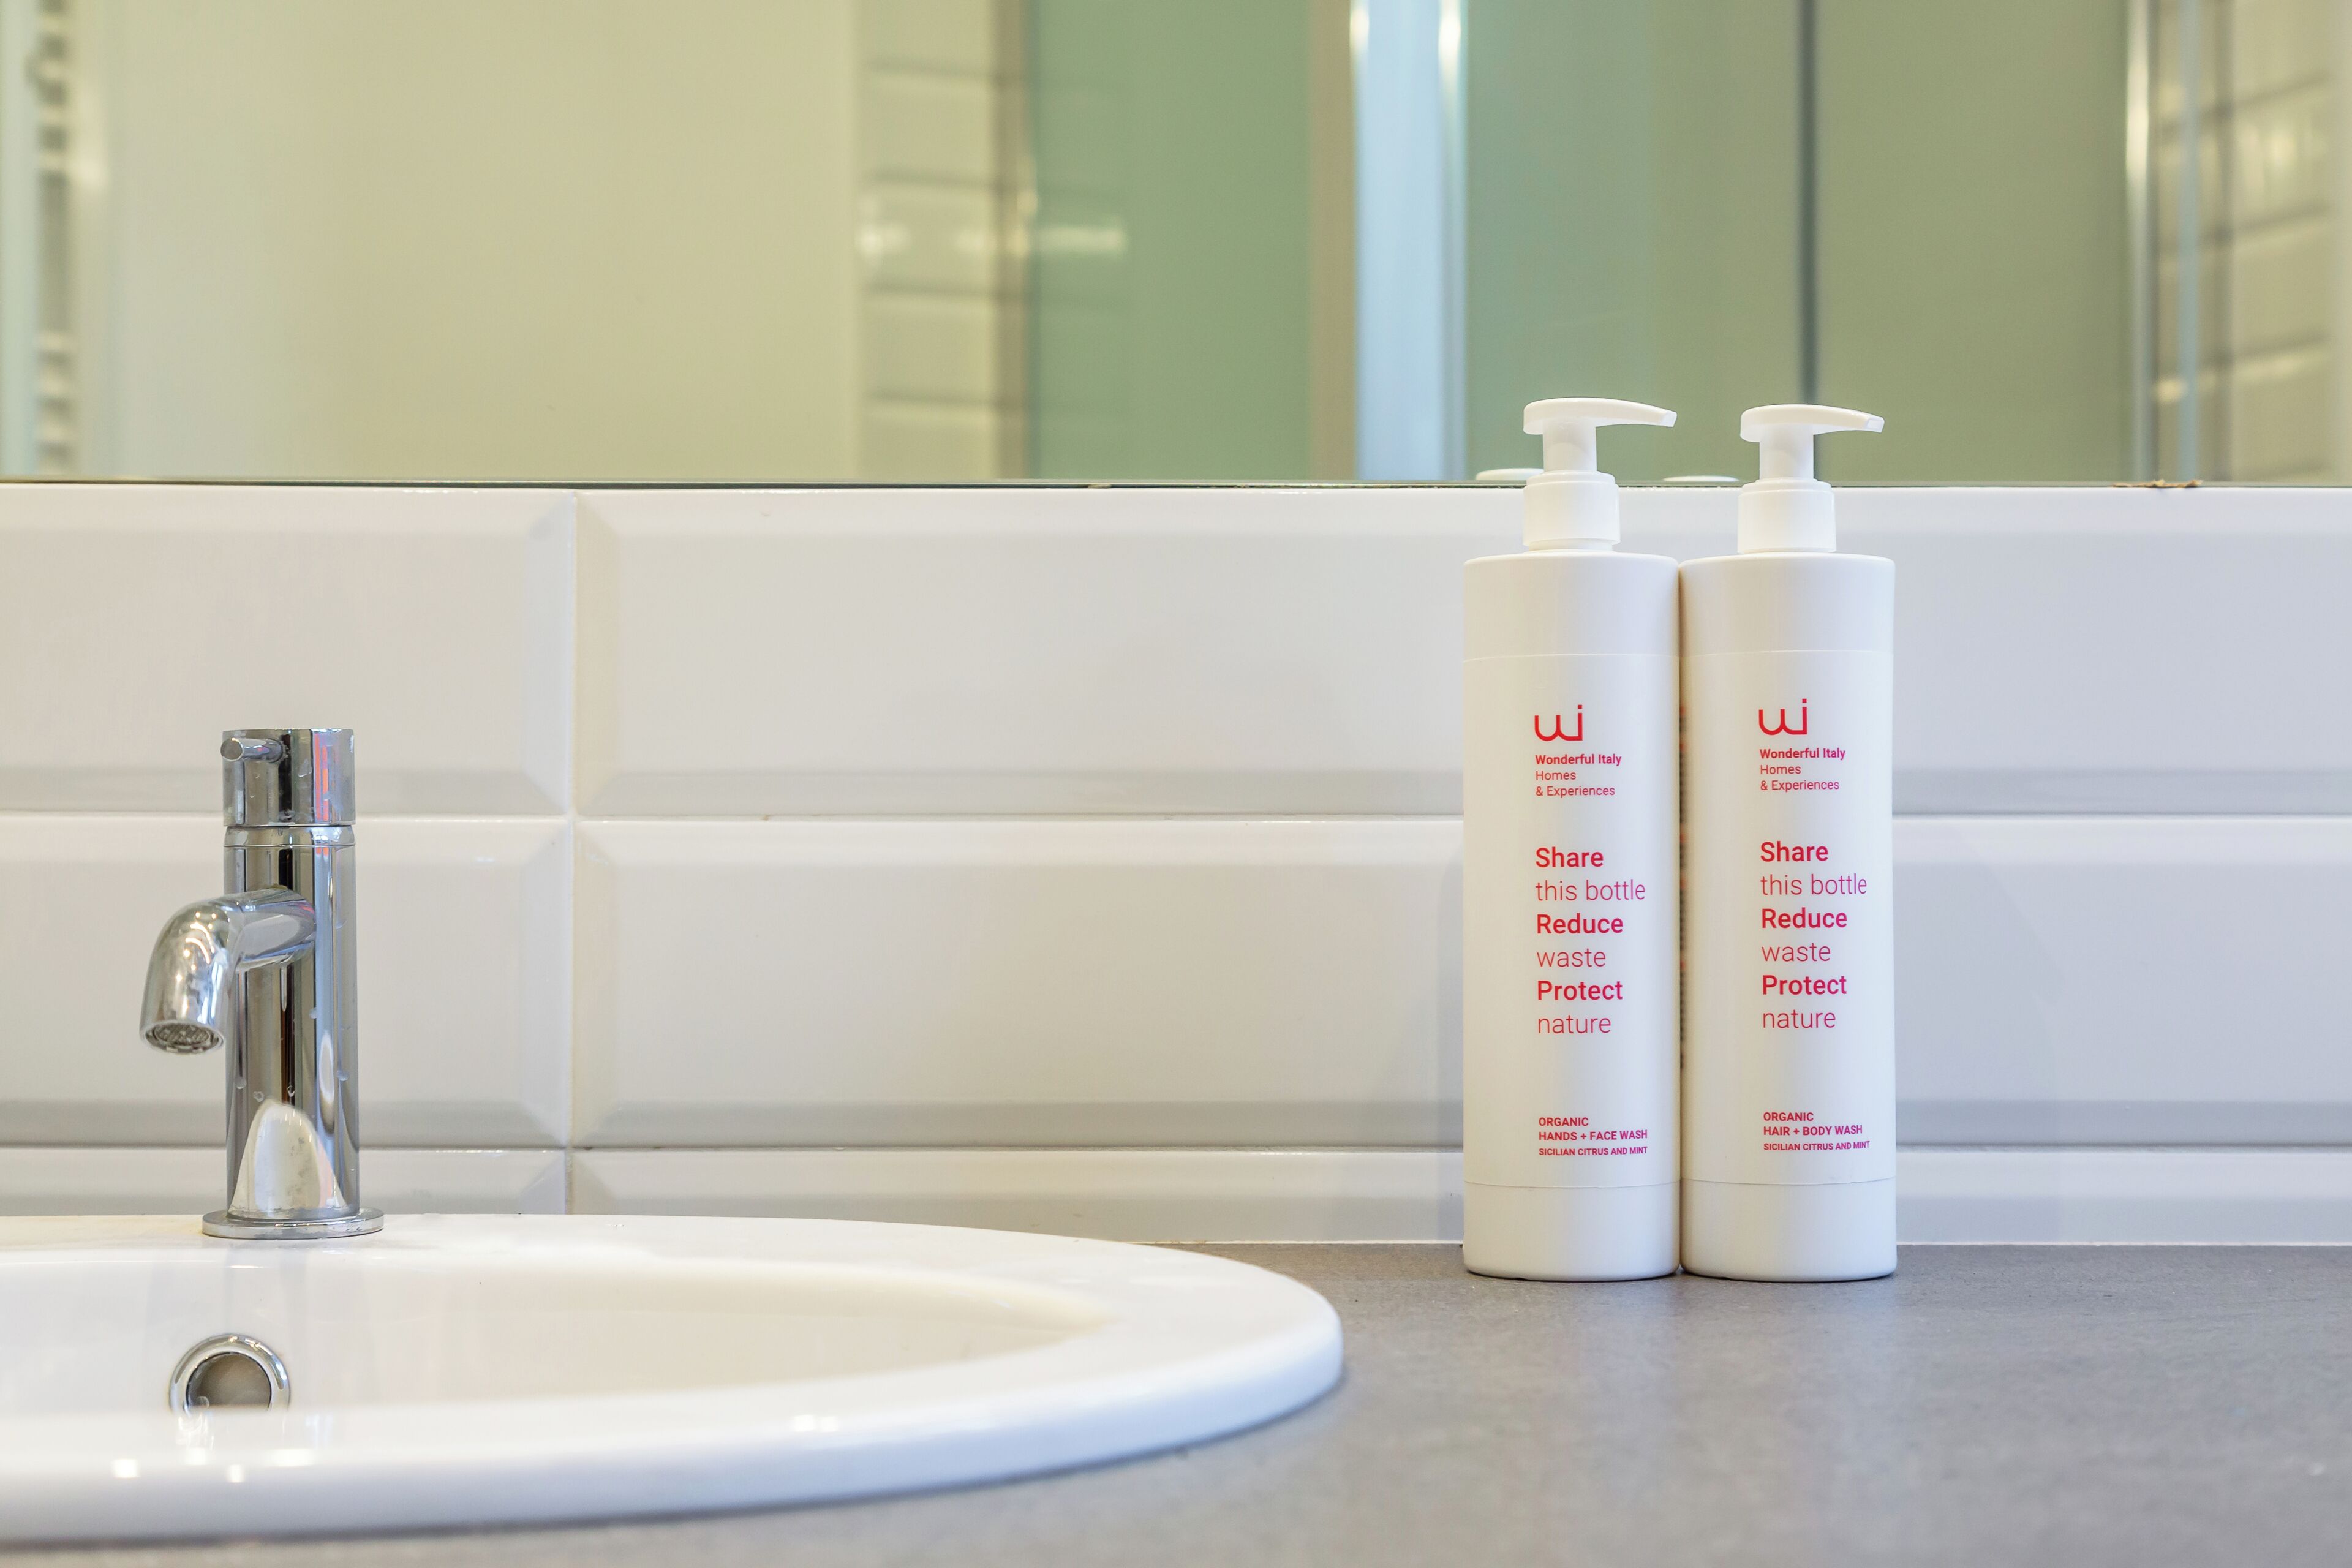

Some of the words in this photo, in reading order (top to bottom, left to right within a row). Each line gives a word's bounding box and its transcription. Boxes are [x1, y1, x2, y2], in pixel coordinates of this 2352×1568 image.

[1535, 753, 1595, 764] Wonderful
[1599, 753, 1622, 766] Italy
[1760, 747, 1819, 759] Wonderful
[1823, 747, 1845, 761] Italy
[1536, 771, 1576, 780] Homes
[1760, 765, 1801, 774] Homes
[1536, 786, 1544, 796] &
[1547, 786, 1615, 798] Experiences
[1760, 780, 1768, 790] &
[1771, 780, 1839, 793] Experiences
[1536, 846, 1604, 868] Share
[1760, 840, 1828, 862] Share
[1535, 880, 1577, 901] this
[1586, 879, 1645, 900] bottle
[1760, 874, 1802, 895] this
[1811, 873, 1867, 895] bottle
[1537, 913, 1624, 934] Reduce
[1762, 907, 1847, 929] Reduce
[1537, 948, 1606, 967] waste
[1762, 943, 1831, 962] waste
[1538, 981, 1623, 1000] Protect
[1763, 975, 1847, 995] Protect
[1539, 1015, 1611, 1034] nature
[1763, 1009, 1836, 1028] nature
[1539, 1117, 1589, 1126] ORGANIC
[1763, 1112, 1814, 1121] ORGANIC
[1539, 1131, 1578, 1140] HANDS
[1589, 1131, 1617, 1140] FACE
[1619, 1129, 1647, 1140] WASH
[1763, 1126, 1790, 1136] HAIR
[1803, 1126, 1832, 1136] BODY
[1834, 1125, 1862, 1135] WASH
[1853, 1140, 1870, 1149] MINT
